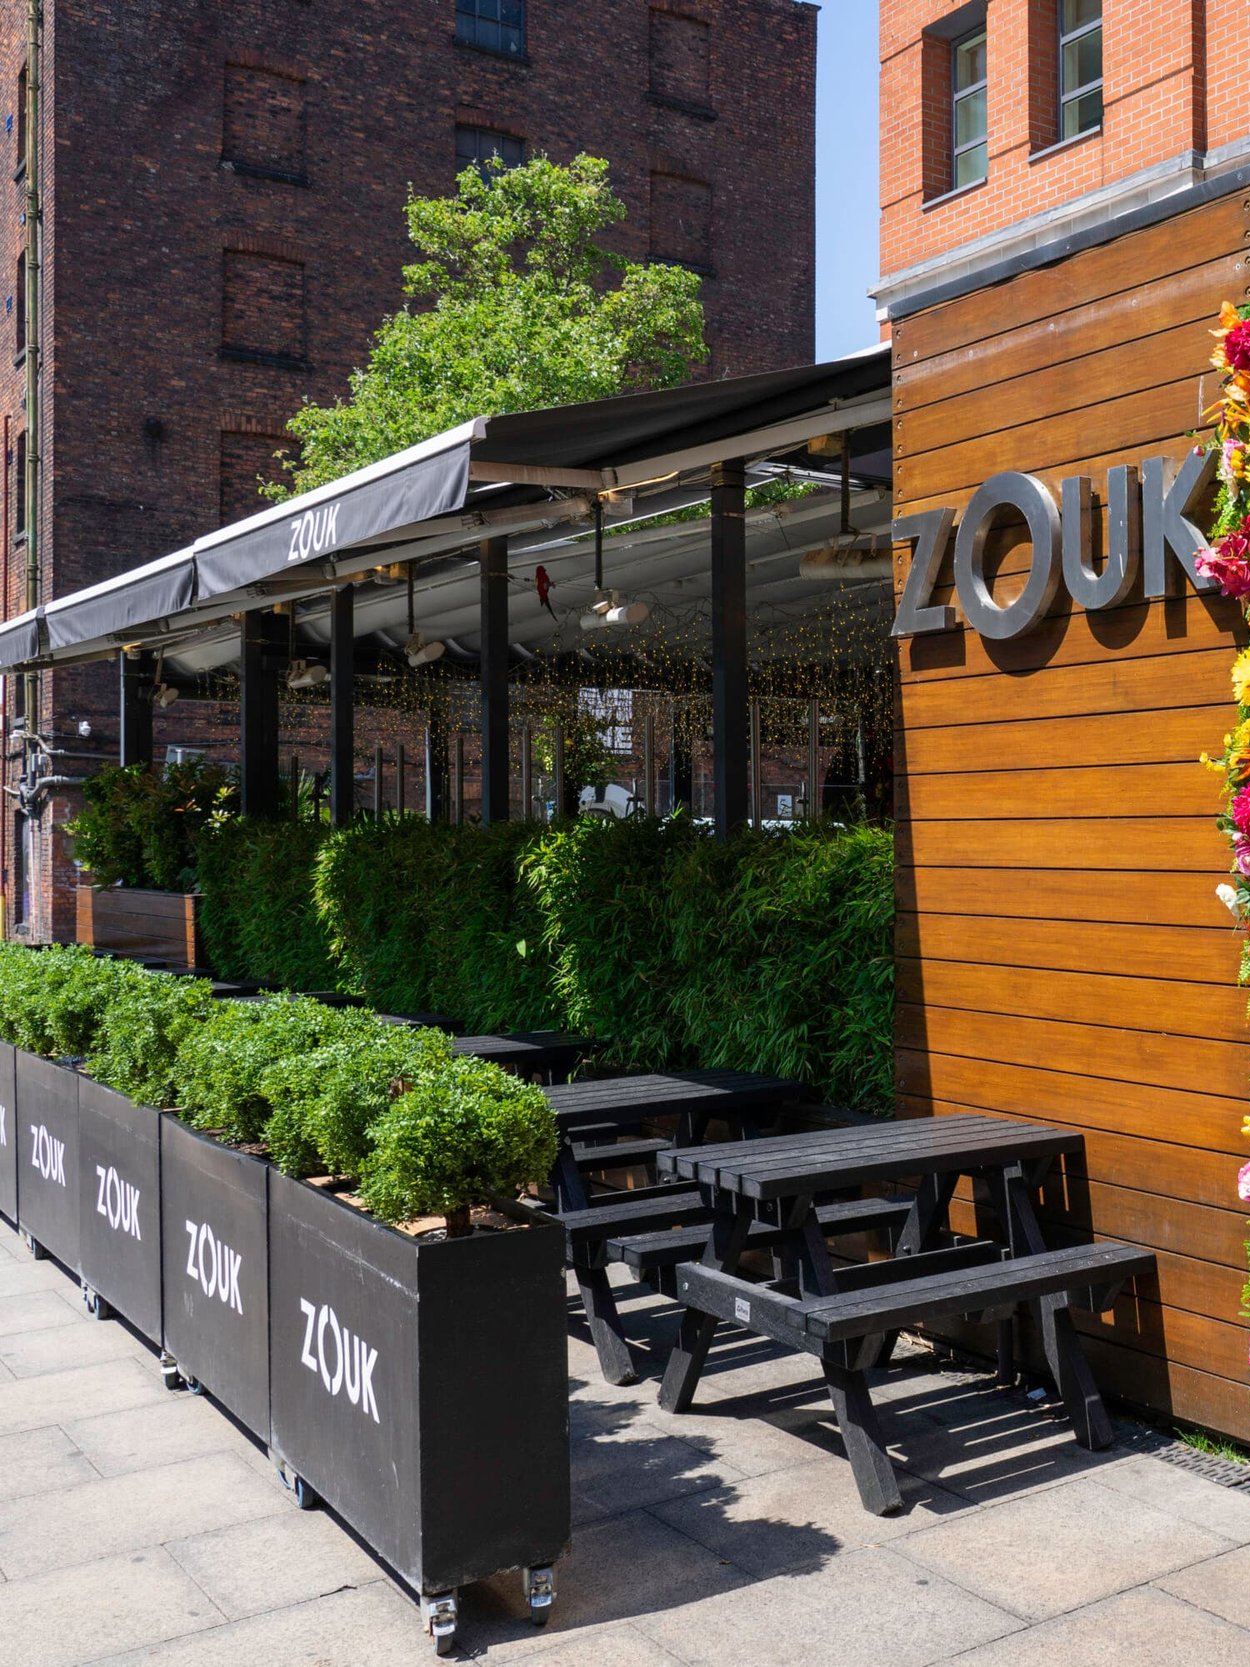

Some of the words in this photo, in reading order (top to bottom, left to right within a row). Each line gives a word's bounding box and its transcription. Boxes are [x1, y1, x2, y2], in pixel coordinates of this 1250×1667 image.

[287, 503, 341, 560] ZOUK
[891, 446, 1221, 640] ZOUK
[30, 1124, 66, 1187] ZOUK
[96, 1164, 142, 1241] ZOUK
[185, 1219, 244, 1315] ZOUK
[300, 1297, 380, 1424] ZOUK
